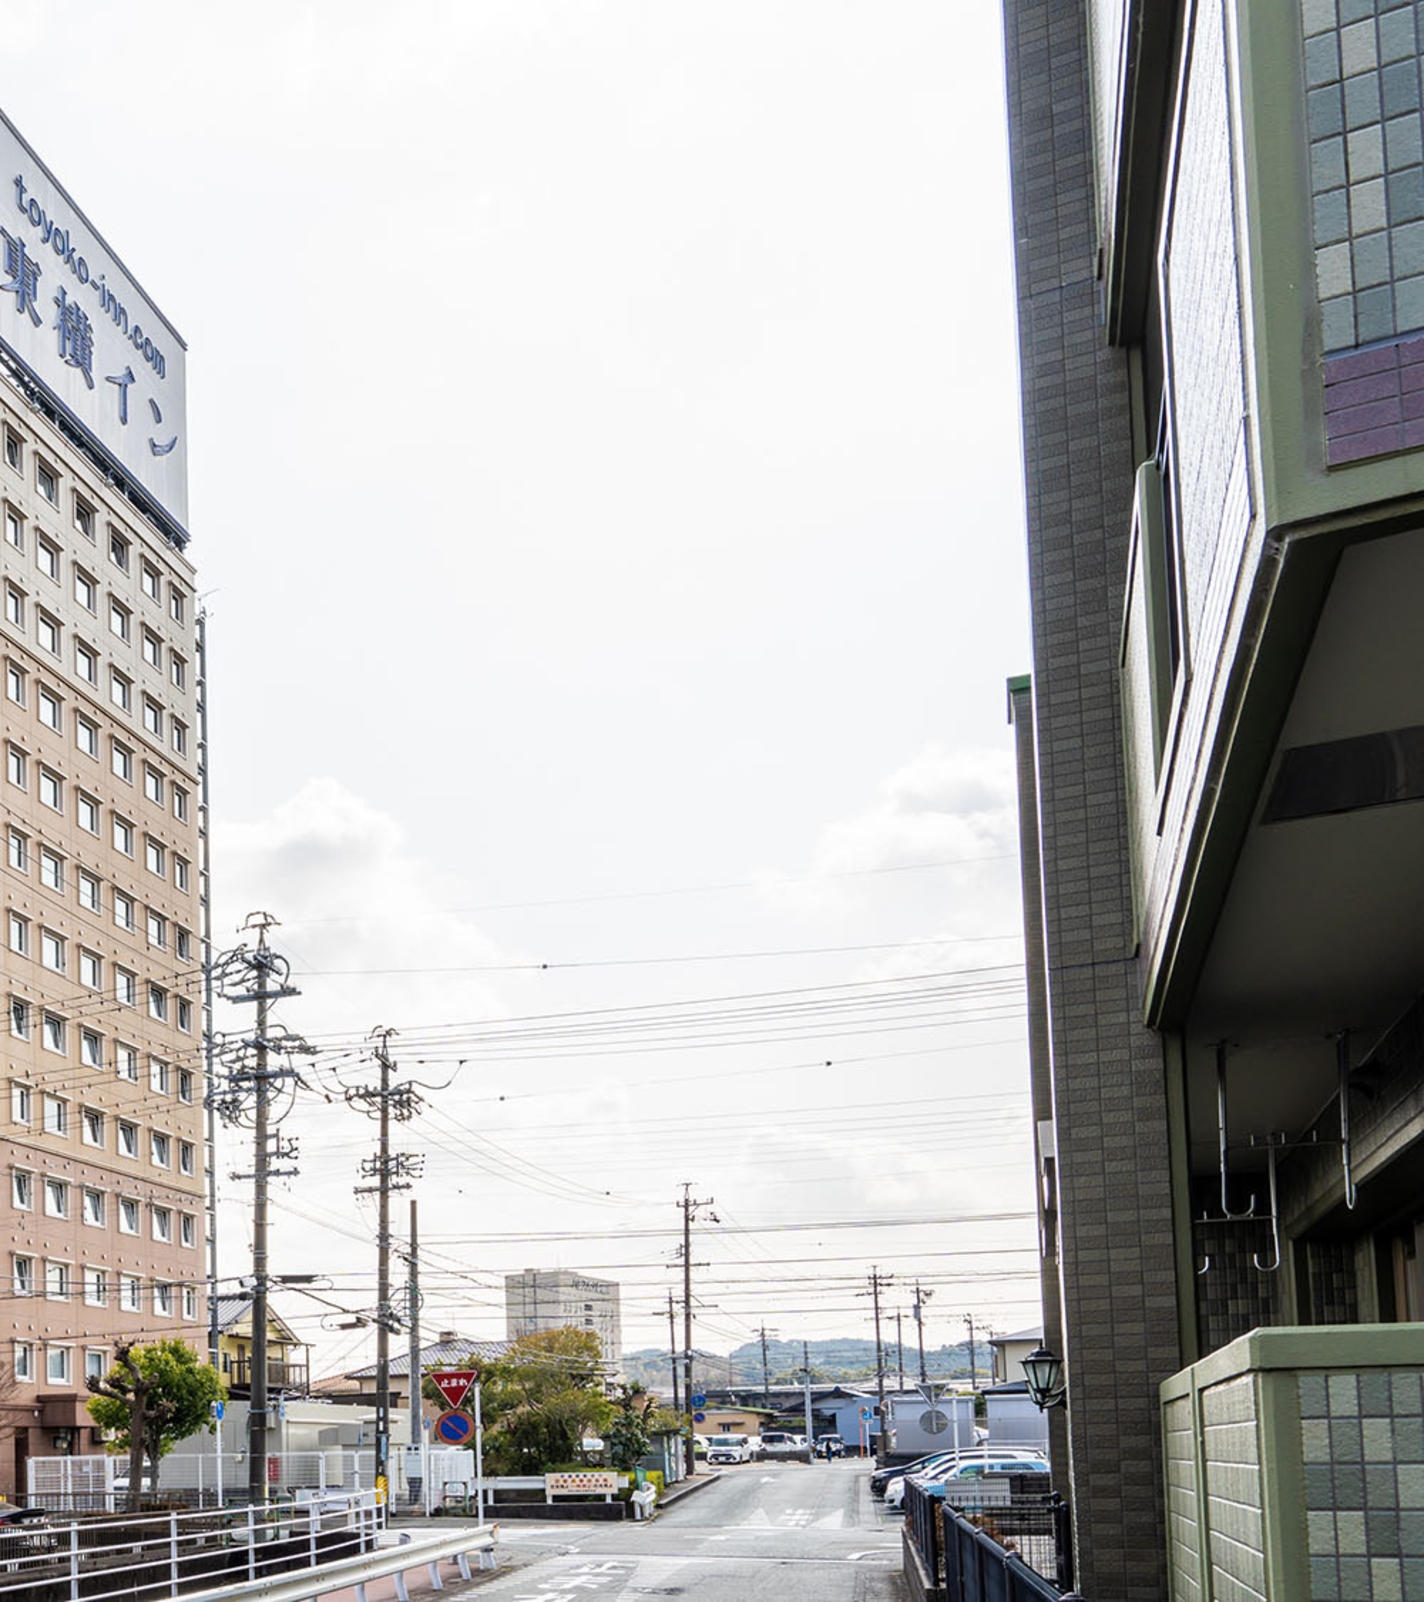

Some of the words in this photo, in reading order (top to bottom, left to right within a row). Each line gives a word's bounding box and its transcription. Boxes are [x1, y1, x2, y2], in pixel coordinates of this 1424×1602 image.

[0, 226, 177, 456] 東横イン
[13, 174, 166, 380] toyoko-inn.com
[441, 1378, 468, 1387] 止まれ
